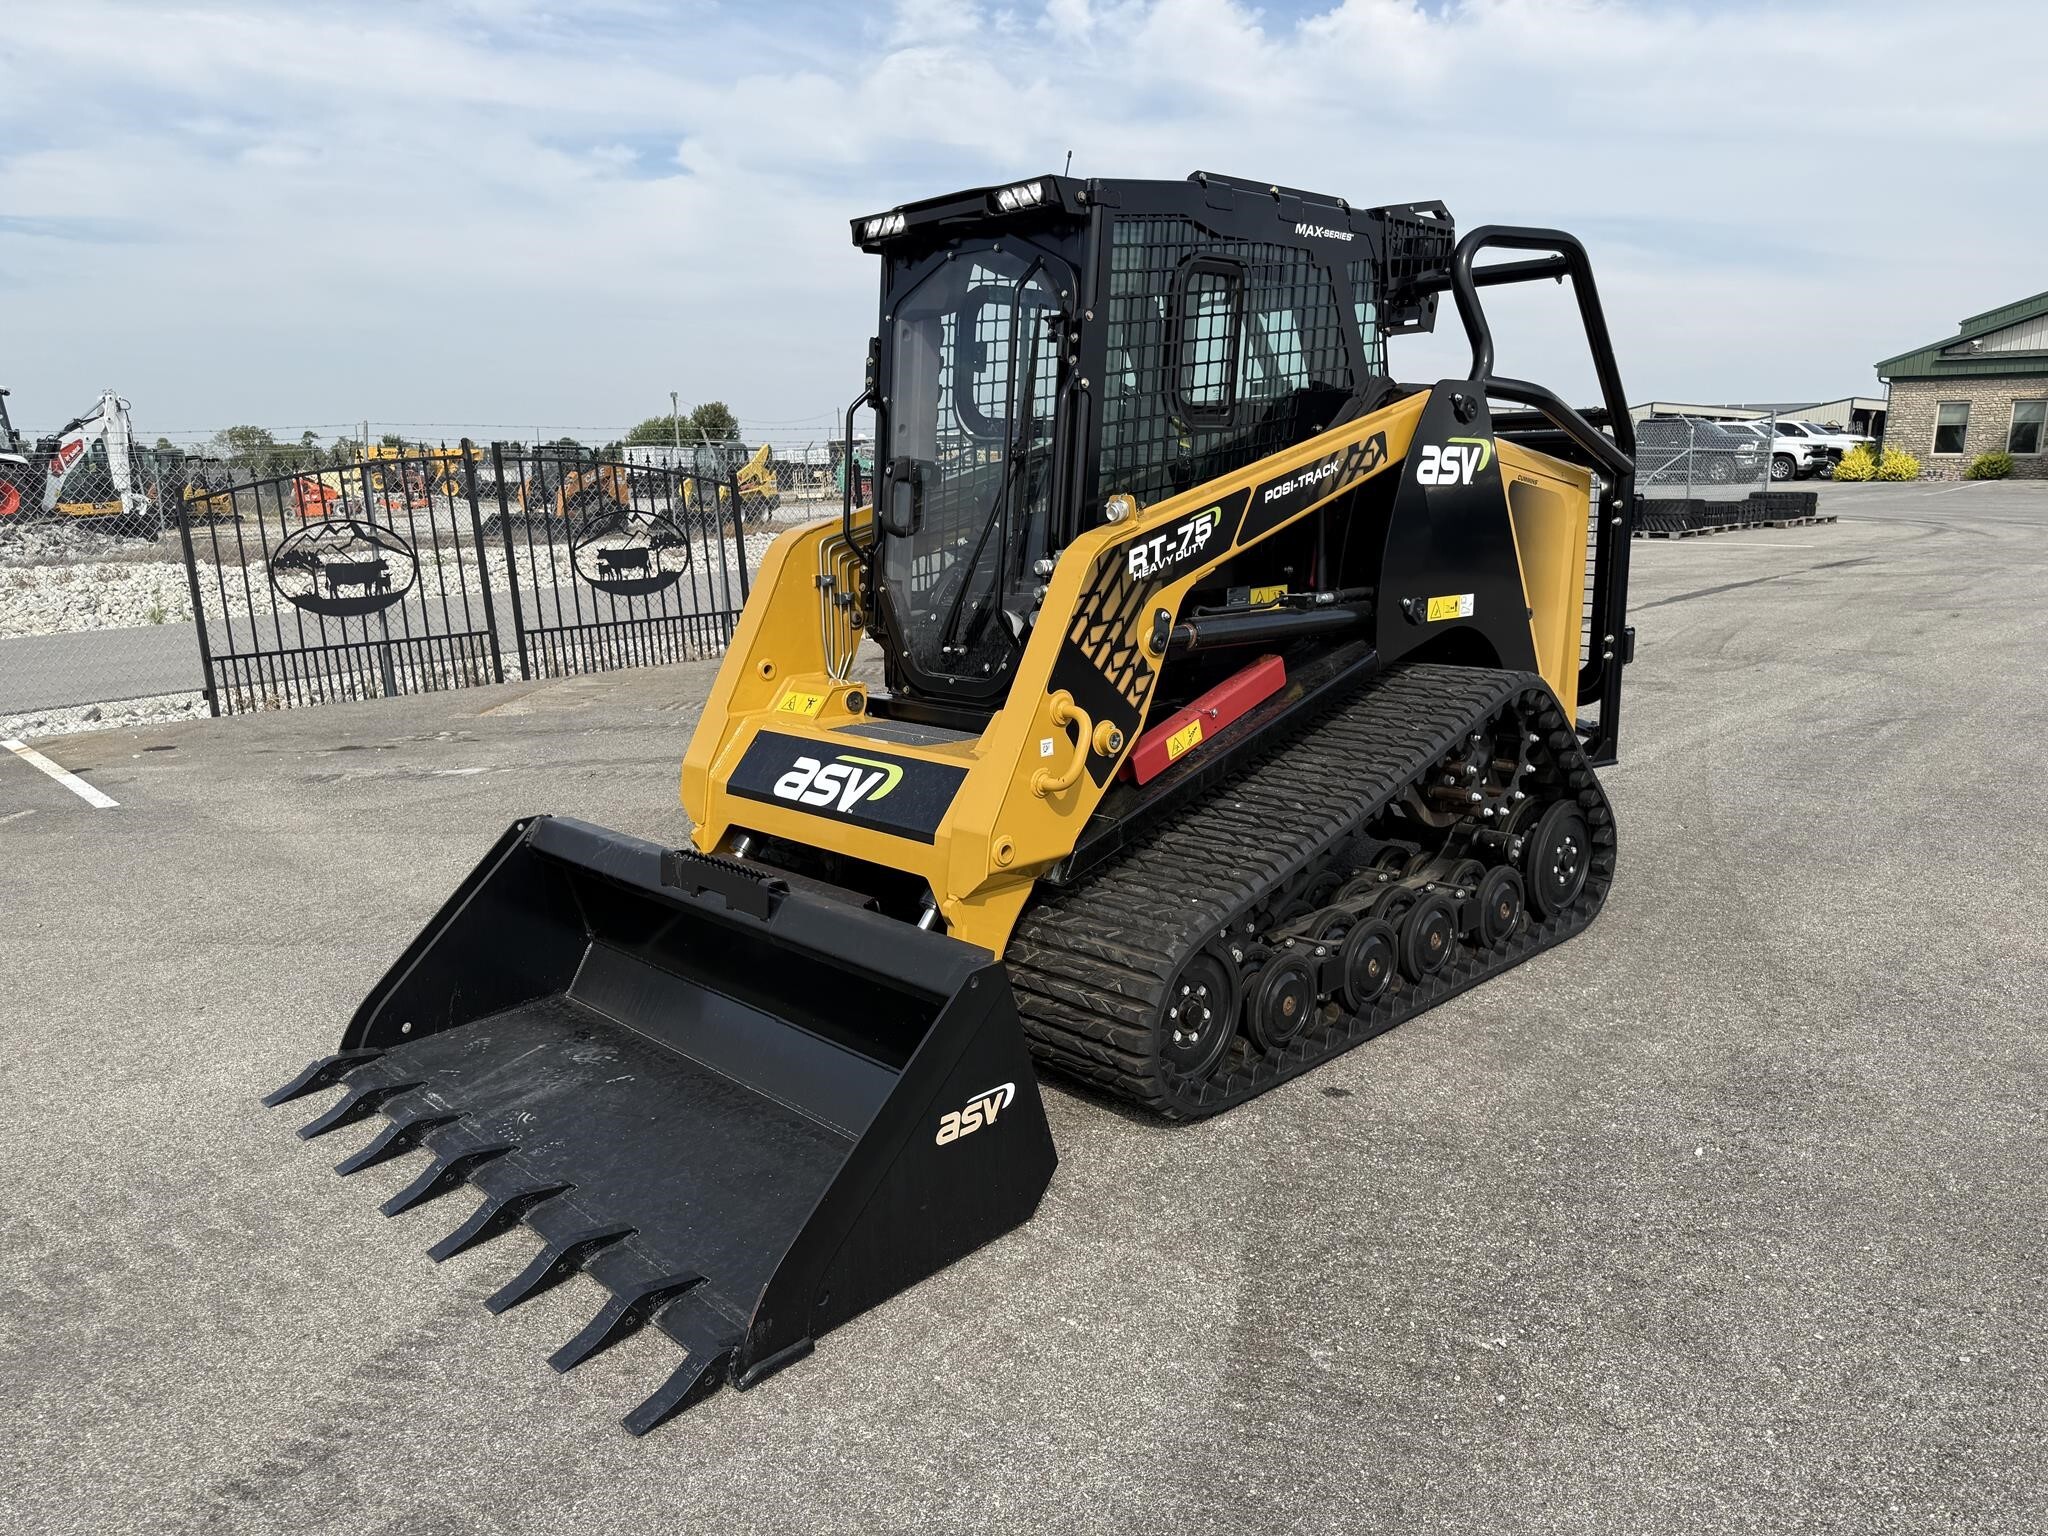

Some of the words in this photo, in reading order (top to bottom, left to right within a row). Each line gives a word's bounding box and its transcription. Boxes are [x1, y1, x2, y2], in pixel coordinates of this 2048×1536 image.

[1265, 460, 1338, 504] POSI-TRACK
[1129, 514, 1212, 574] RT-75
[1133, 554, 1174, 581] HEAVY
[1175, 539, 1206, 562] DUTY
